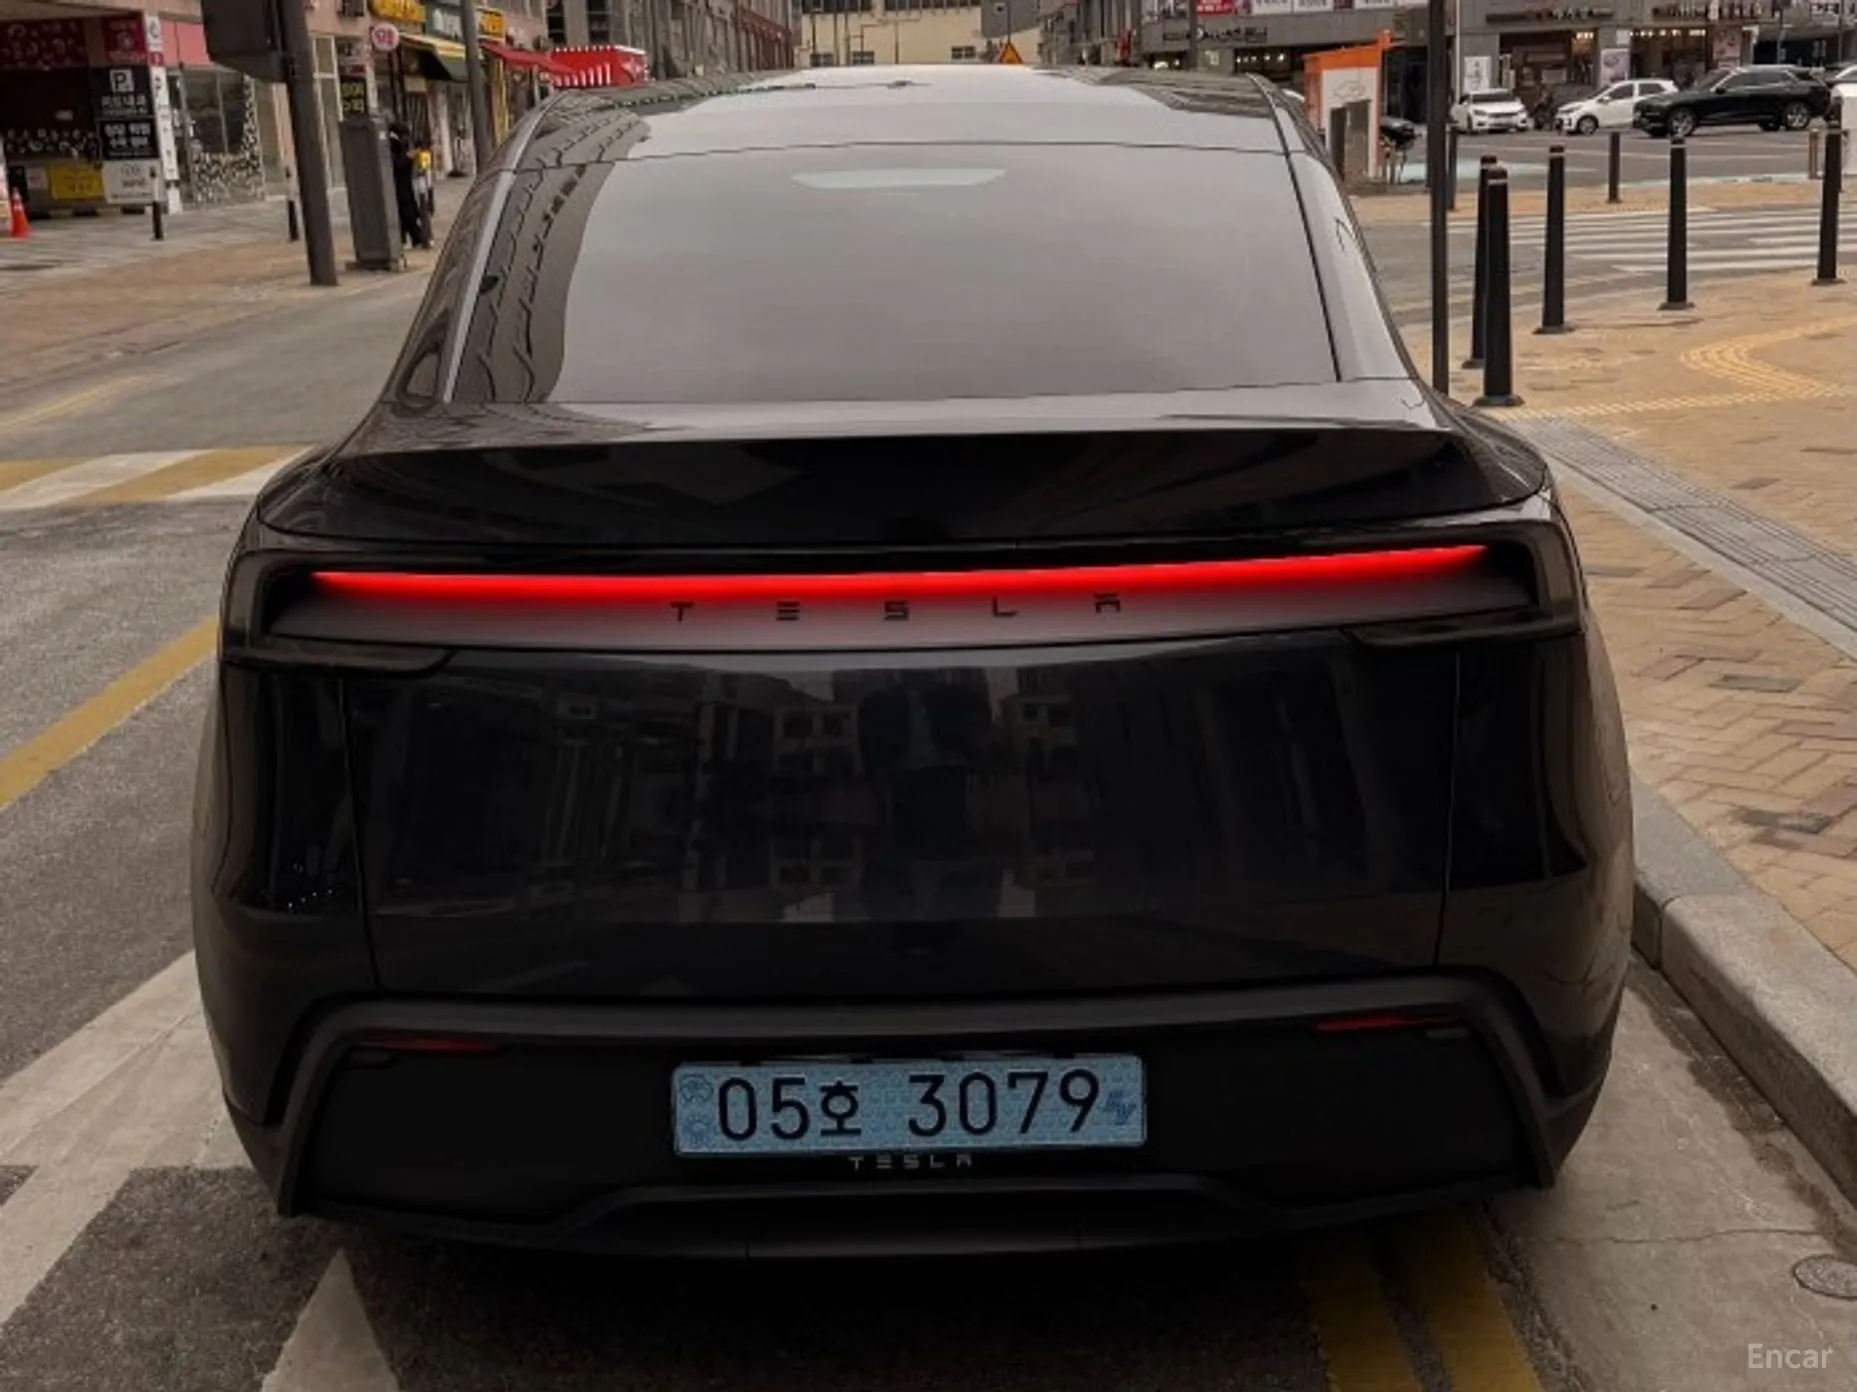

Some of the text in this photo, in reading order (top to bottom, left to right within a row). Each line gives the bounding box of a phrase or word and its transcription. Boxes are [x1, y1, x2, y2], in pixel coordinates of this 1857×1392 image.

[112, 72, 128, 89] P
[668, 592, 1121, 622] TESLA
[717, 1068, 1101, 1141] 05호 3079
[847, 1153, 972, 1170] TESLA
